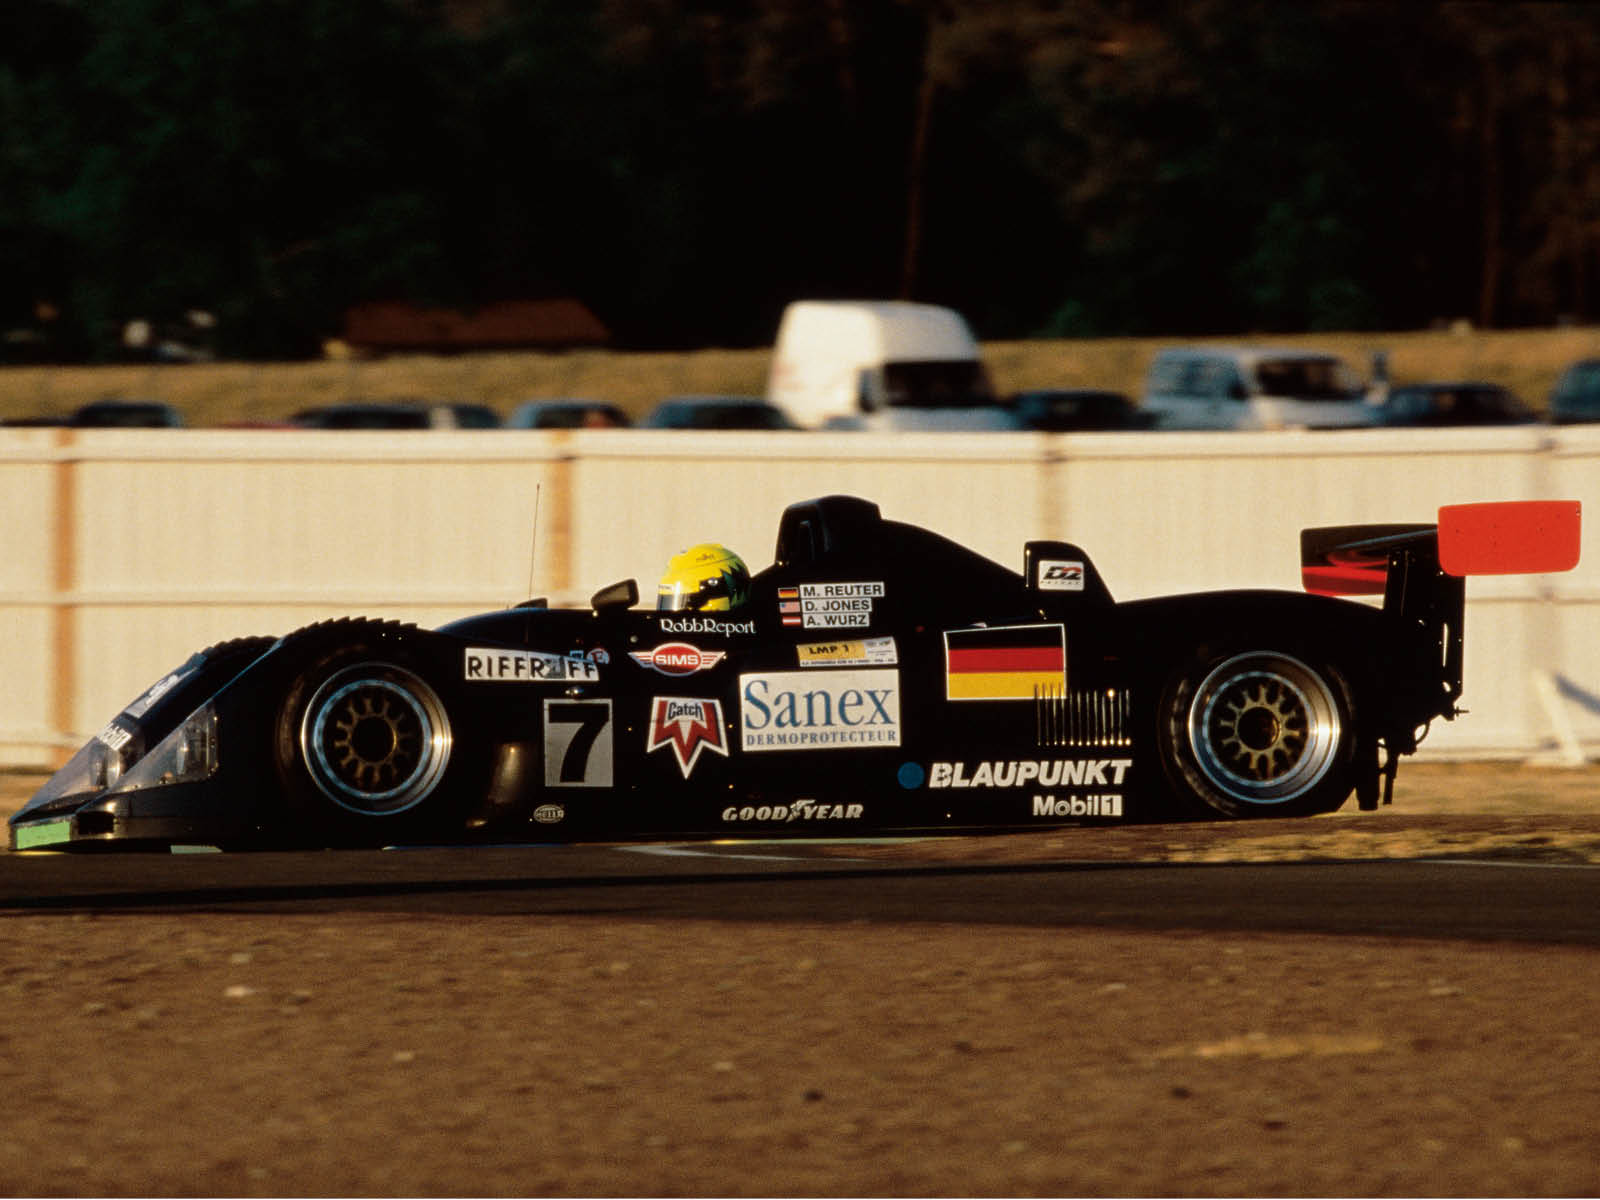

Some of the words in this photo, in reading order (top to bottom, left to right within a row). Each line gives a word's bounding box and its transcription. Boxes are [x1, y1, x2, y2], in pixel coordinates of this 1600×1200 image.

[803, 586, 820, 597] M.
[824, 584, 883, 597] REUTER
[805, 600, 819, 612] D.
[822, 599, 870, 611] JONES
[806, 615, 821, 626] A.
[824, 614, 868, 626] WURZ
[808, 645, 837, 655] LMP
[467, 655, 596, 678] RIFFRFF
[654, 655, 699, 666] SIMS
[668, 701, 704, 720] Catch
[744, 680, 897, 730] Sanex
[549, 703, 609, 783] 7
[746, 730, 897, 747] DERMOPROTECTEUR
[929, 759, 1132, 788] BLAUPUNKT
